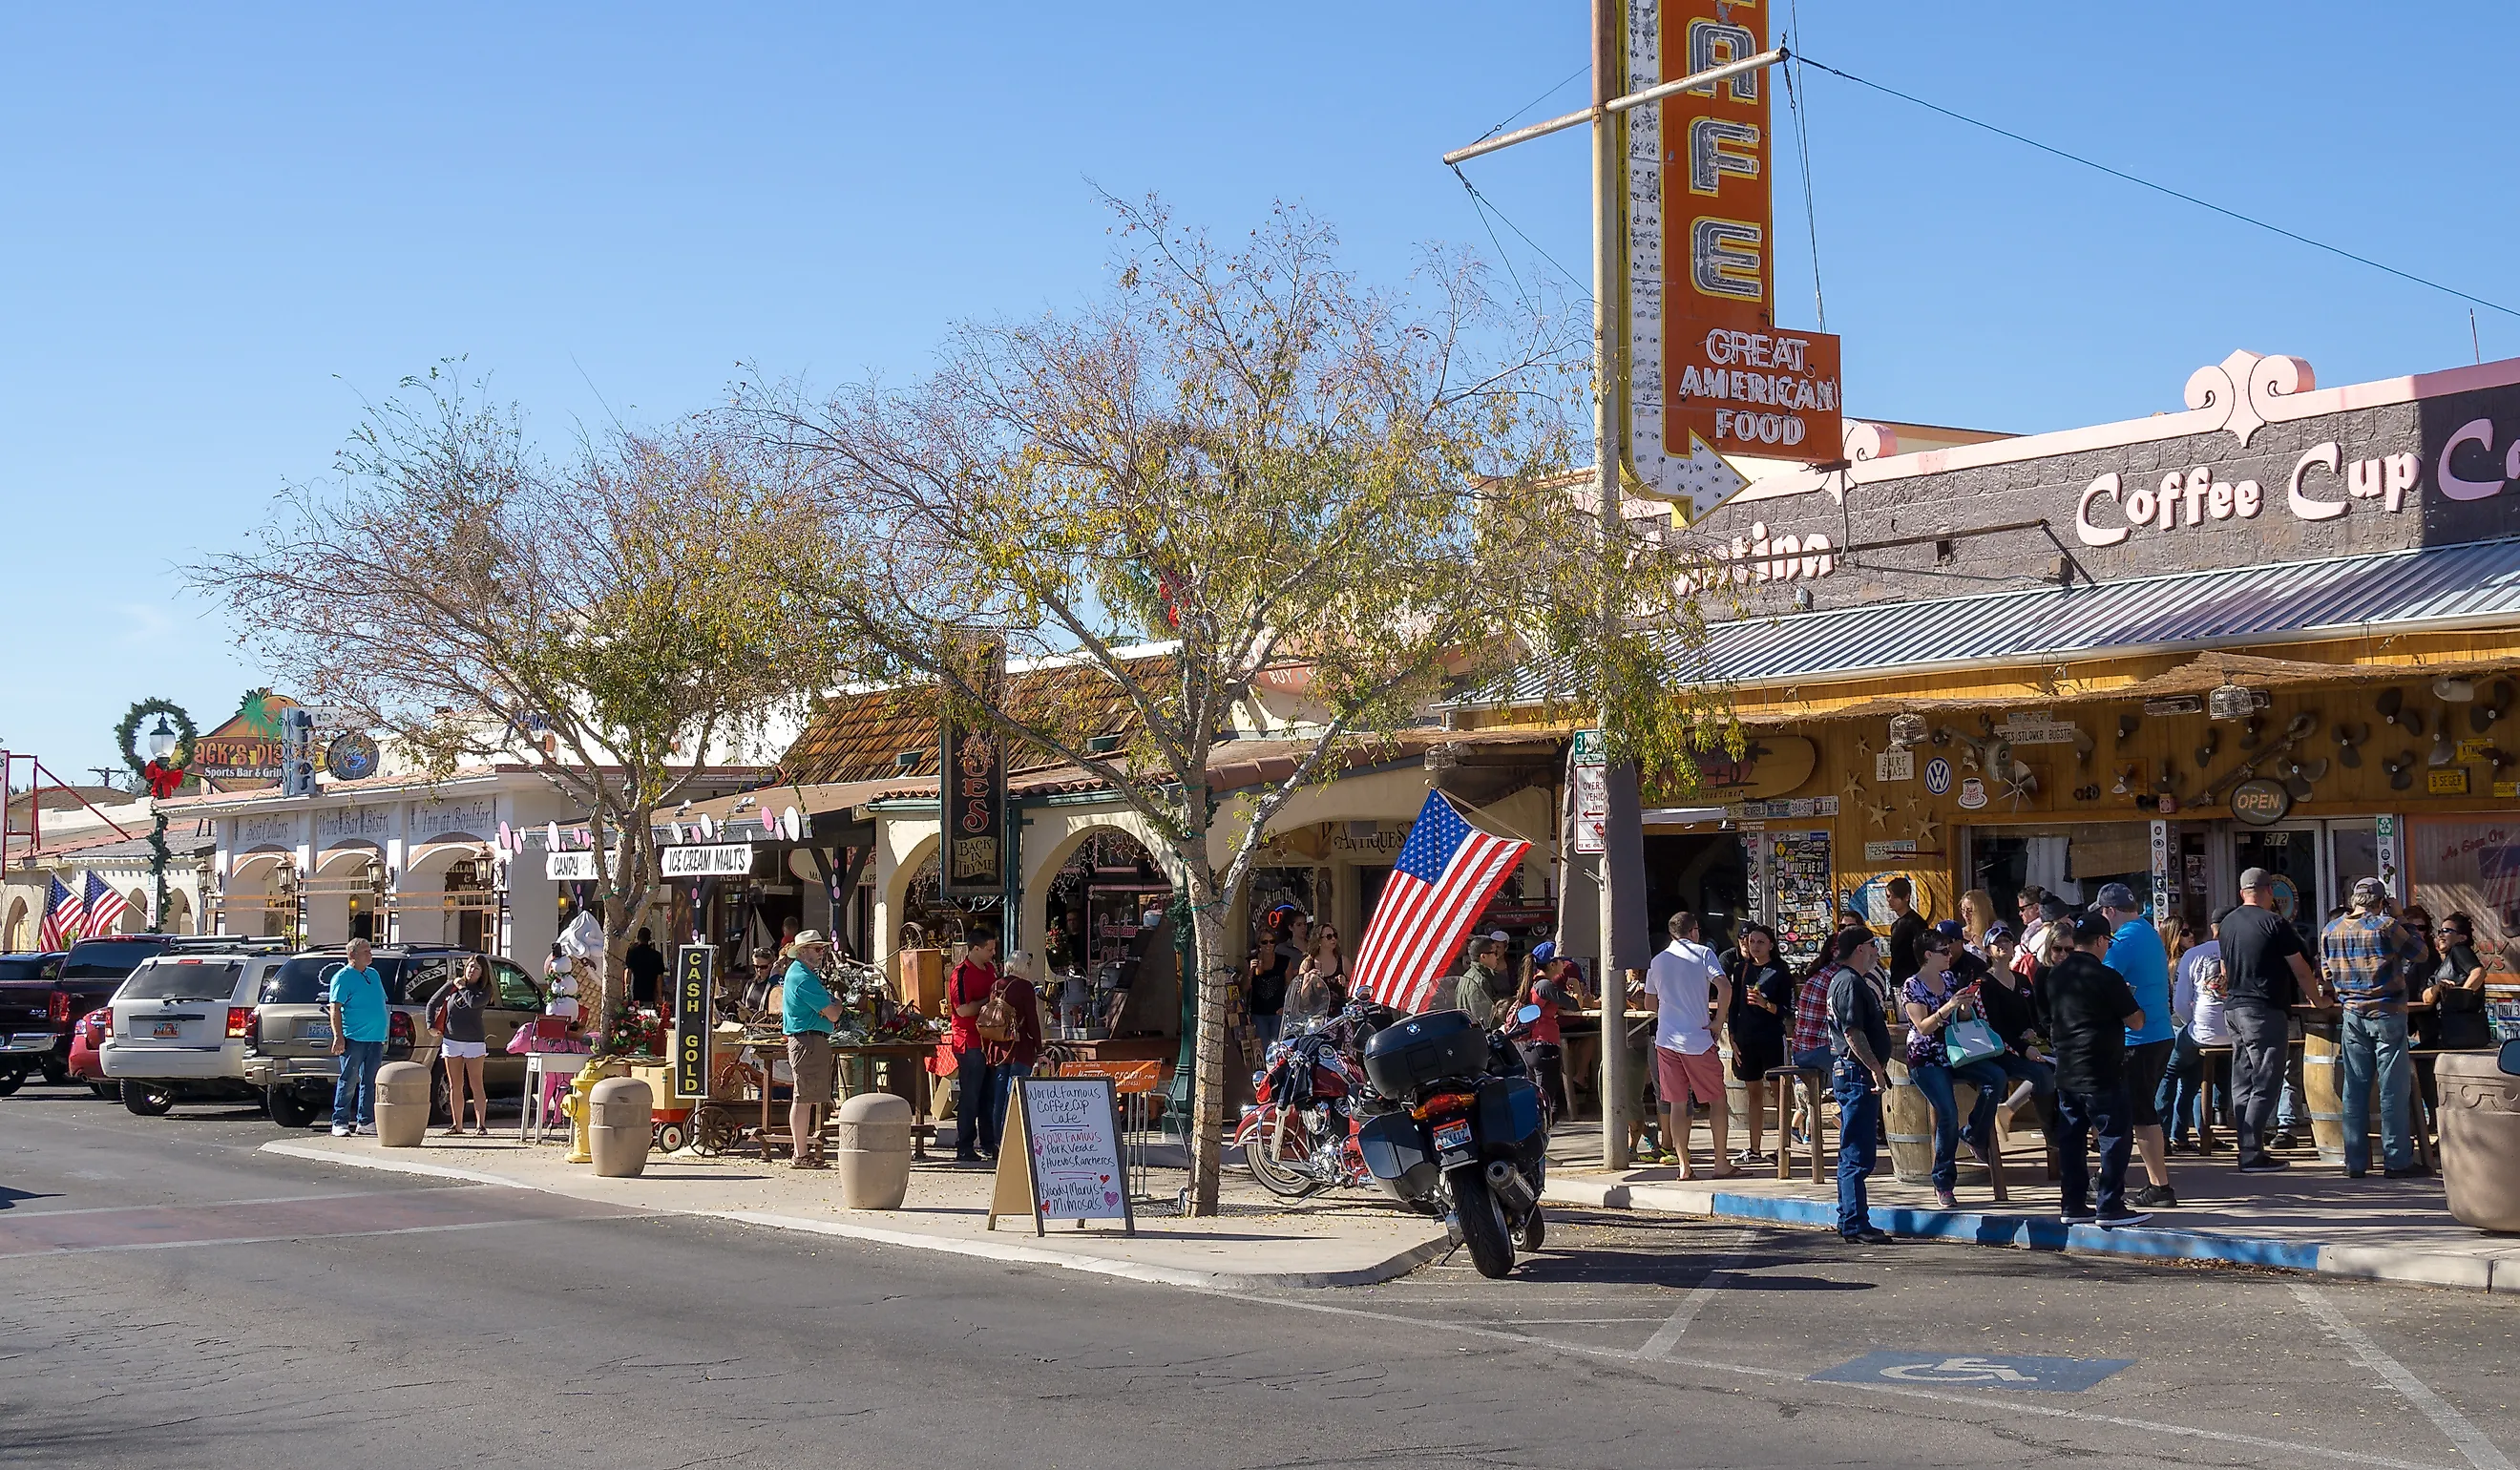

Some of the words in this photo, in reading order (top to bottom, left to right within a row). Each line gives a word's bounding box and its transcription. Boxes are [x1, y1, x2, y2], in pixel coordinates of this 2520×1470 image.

[1686, 0, 1763, 304] AFE
[1705, 327, 1811, 371] GREAT
[1678, 365, 1839, 411] AMERICAN
[1715, 408, 1807, 446] FOOD
[2075, 467, 2263, 547] Coffee
[2287, 441, 2421, 521] Cup
[1576, 734, 1584, 752] 3
[194, 742, 247, 766] ACK'S
[204, 766, 235, 779] Sports
[236, 767, 253, 778] Bar
[254, 767, 262, 777] &
[262, 767, 283, 778] Grill
[1583, 782, 1604, 790] OVERS
[1585, 793, 1604, 802] VEHIC
[2237, 794, 2280, 809] OPEN
[318, 811, 339, 836] Wine
[344, 811, 360, 835] Bar
[423, 809, 438, 832] Inn
[440, 811, 451, 831] at
[452, 801, 491, 830] Boulder
[245, 819, 262, 841] Best
[262, 813, 289, 842] Cellars
[958, 838, 992, 856] BACK
[2265, 833, 2288, 845] 512
[668, 850, 682, 872] ICE
[682, 849, 711, 872] CREAM
[971, 850, 982, 861] IN
[2441, 845, 2459, 861] As
[554, 855, 579, 876] CANDY
[956, 858, 995, 877] THYME
[1252, 890, 1272, 923] Back
[1271, 888, 1281, 902] in
[685, 952, 702, 1013] CASH
[684, 1034, 699, 1092] GOLD
[1027, 1085, 1060, 1101] World
[1060, 1085, 1102, 1100] Famous
[1038, 1100, 1073, 1113] Coffee
[1072, 1099, 1090, 1115] Cup
[1051, 1112, 1082, 1124] Cafe
[1046, 1132, 1063, 1144] OUR
[1046, 1143, 1069, 1155] Pork
[1069, 1142, 1099, 1154] Verde
[1046, 1156, 1075, 1169] Huevos
[1073, 1154, 1116, 1167] Rancheros
[1040, 1182, 1070, 1201] Bloody
